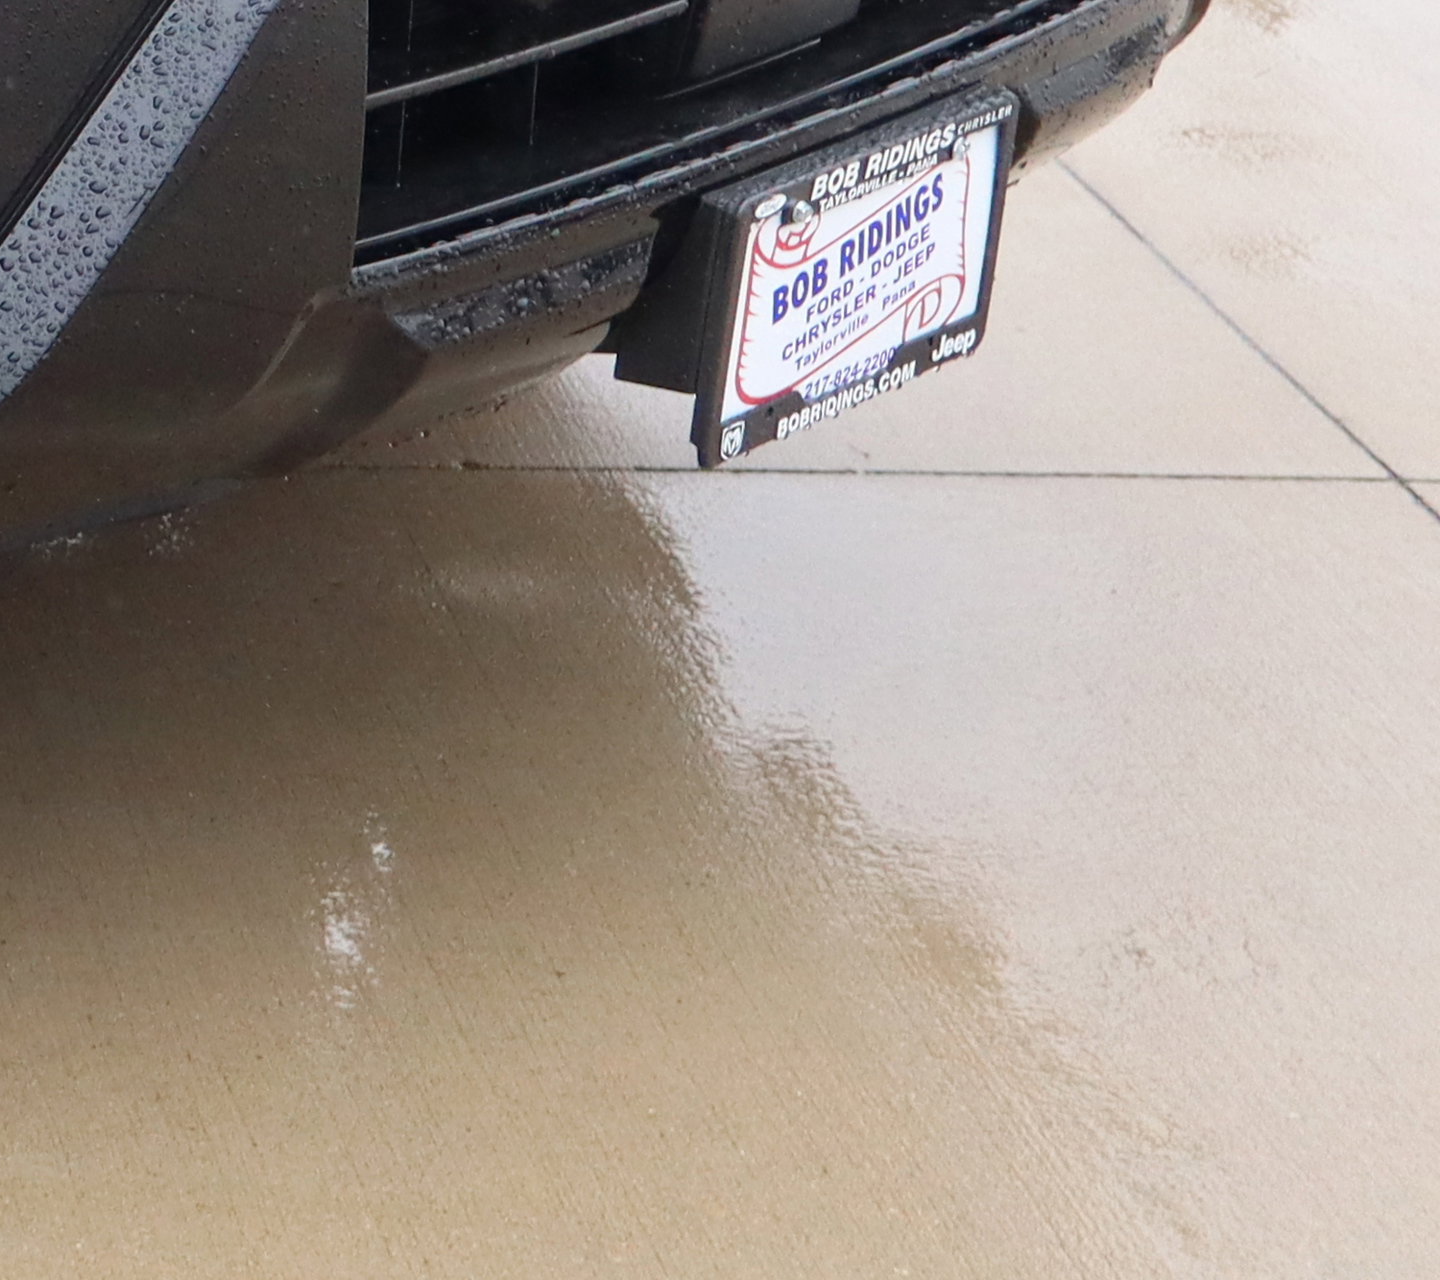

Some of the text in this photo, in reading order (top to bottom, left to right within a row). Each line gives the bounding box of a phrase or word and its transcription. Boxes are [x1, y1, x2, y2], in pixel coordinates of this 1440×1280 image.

[957, 104, 1013, 135] CHRYSLER
[811, 123, 957, 201] BOB RIDINGS
[819, 170, 897, 213] TAYLORVILLE
[906, 153, 938, 178] PANA
[772, 172, 944, 325] BOB RIDINGS
[806, 279, 854, 324] FORD
[871, 222, 930, 278] DODGE
[781, 284, 877, 361] CHRYSLER
[893, 242, 936, 285] JEEP
[794, 280, 916, 371] Taylorville Pana
[804, 346, 897, 400] 217-824-2200
[931, 328, 977, 362] Jeep
[776, 360, 917, 440] BOBRIDINGS.COM
